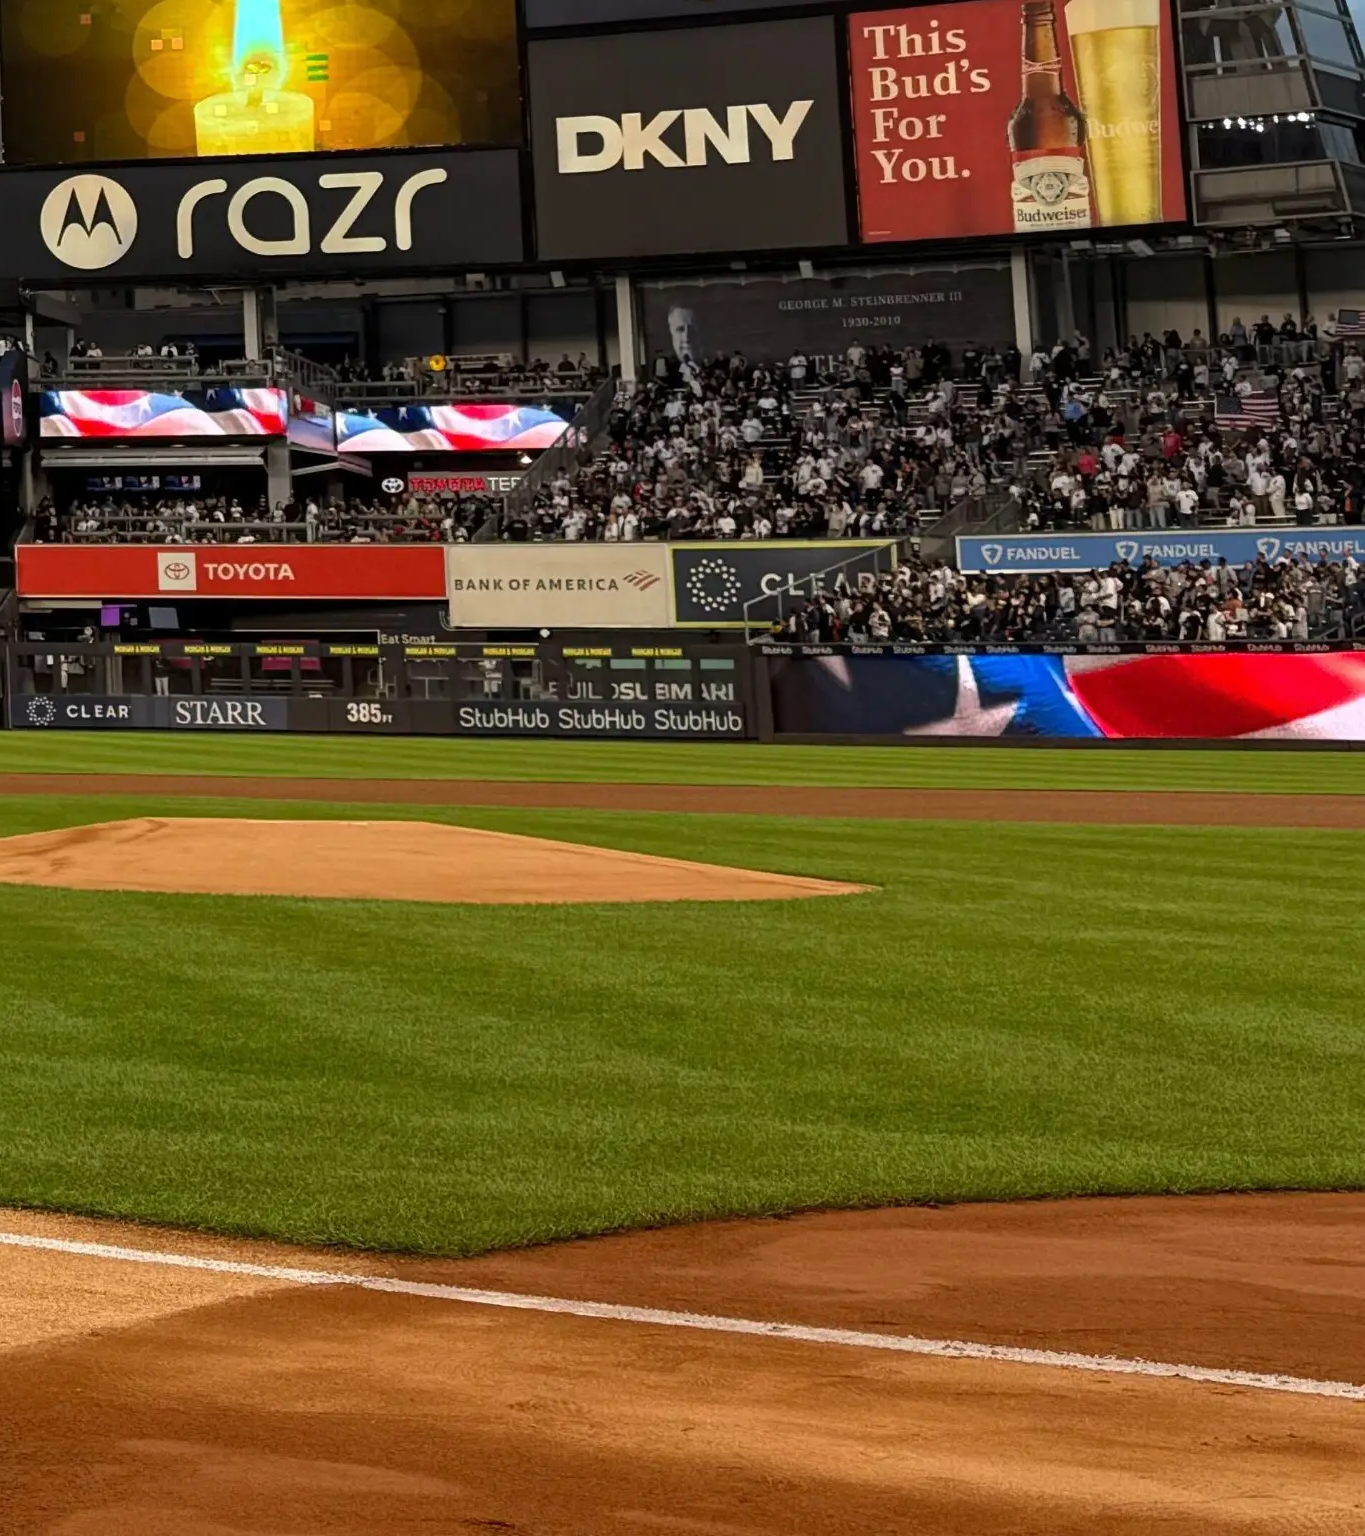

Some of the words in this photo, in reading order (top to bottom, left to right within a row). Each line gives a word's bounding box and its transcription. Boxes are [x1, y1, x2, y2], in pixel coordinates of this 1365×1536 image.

[863, 19, 967, 60] This
[867, 59, 991, 101] Bud's
[870, 107, 947, 143] For
[555, 99, 815, 175] DKNY
[870, 148, 971, 183] You.
[176, 168, 448, 260] razr
[1016, 206, 1087, 223] Budweiser
[778, 298, 829, 311] GEORGE
[831, 297, 847, 309] M.
[850, 292, 945, 308] STEINBRENNER
[948, 290, 963, 302] III
[841, 315, 901, 328] 1930-2010
[1006, 546, 1080, 560] FANDUEL
[1142, 544, 1219, 559] FANDUEL
[203, 563, 295, 581] TOYOTA
[454, 578, 504, 592] BANK
[507, 577, 531, 592] OF
[536, 577, 619, 592] AMERICA
[381, 634, 400, 644] Eat
[402, 634, 436, 644] Smart
[66, 704, 130, 719] CLEAR
[175, 701, 267, 726] STARR
[459, 707, 550, 730] StubHub
[558, 708, 646, 730] StubHub
[654, 709, 743, 732] StubHub
